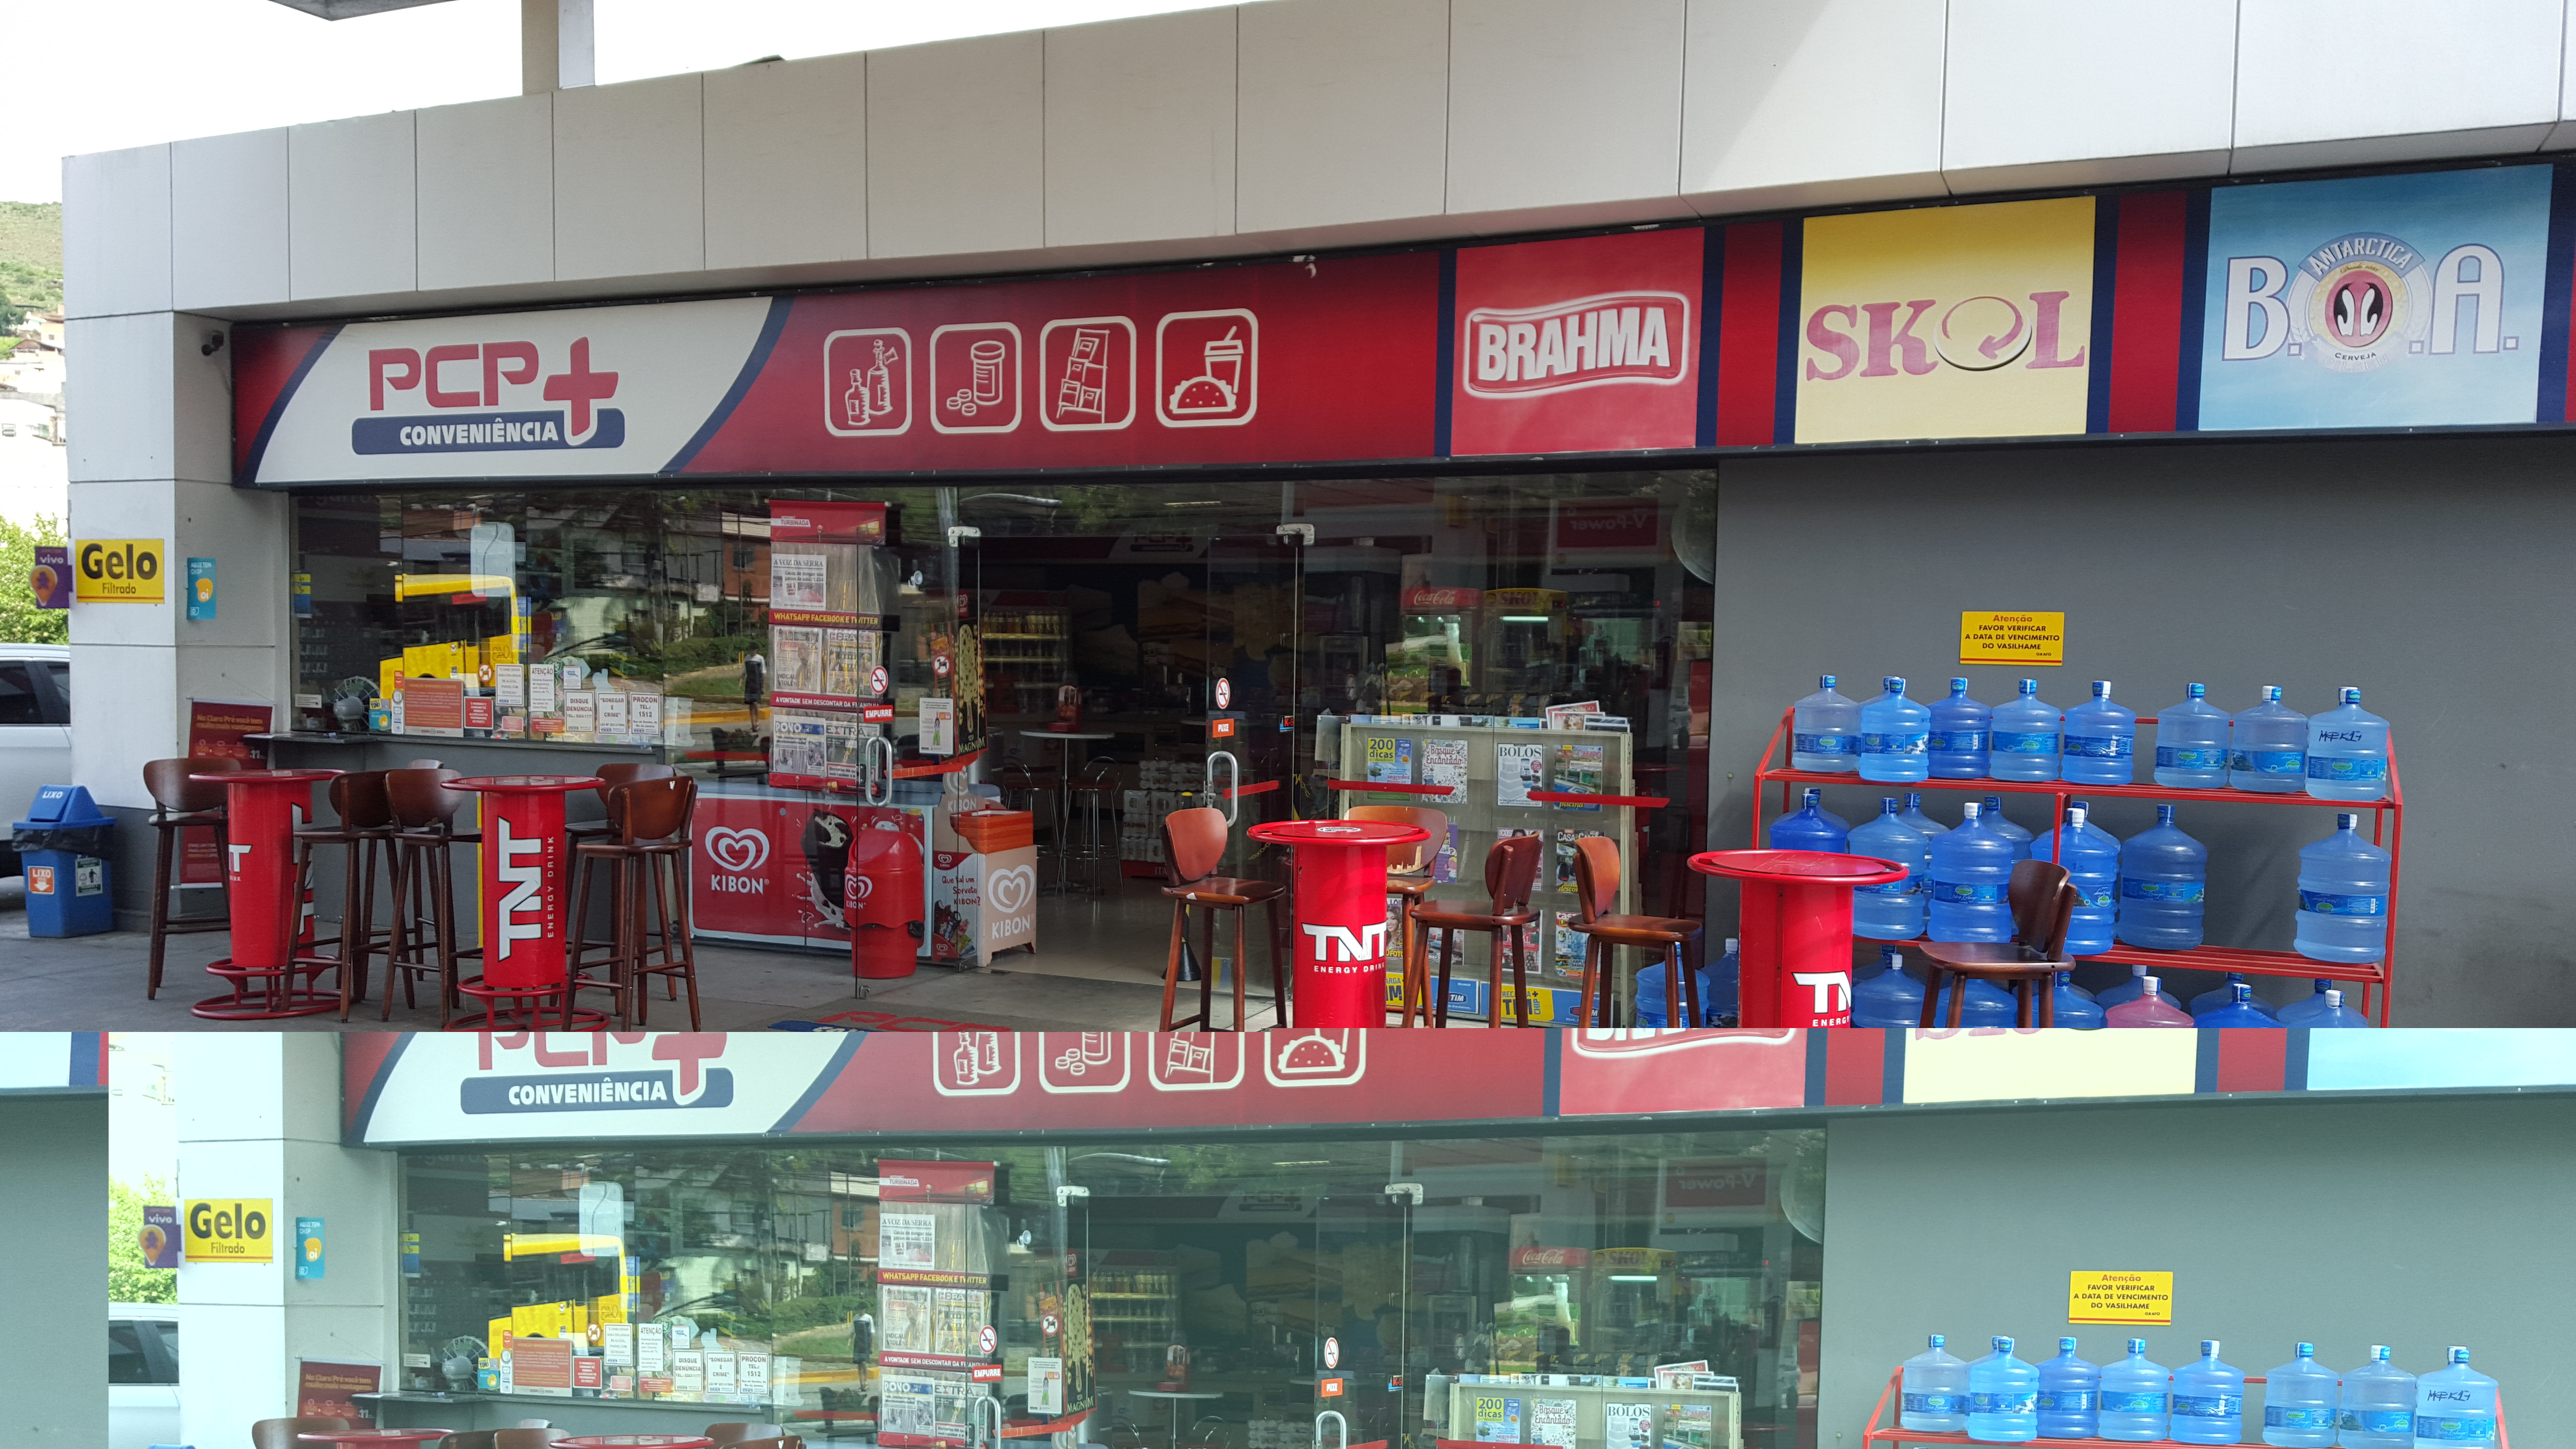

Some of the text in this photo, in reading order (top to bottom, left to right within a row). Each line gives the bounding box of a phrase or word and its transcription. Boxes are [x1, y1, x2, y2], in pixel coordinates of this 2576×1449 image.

[2307, 237, 2413, 275] ANTARCTICA
[1805, 290, 2085, 381] SKOL
[1478, 306, 1670, 382] BRAHMA
[2334, 352, 2377, 361] CERVEJA
[400, 418, 559, 446] CONVENIÊNCIA
[40, 554, 64, 564] vivo
[81, 543, 157, 580] Gelo
[102, 582, 136, 594] Filtrado
[200, 588, 209, 599] oi
[773, 612, 810, 621] WHATSAPP
[811, 614, 845, 623] FACEBOOK
[851, 616, 878, 625] TWITTER
[1993, 614, 2033, 624] Atenção
[532, 667, 553, 676] ATENÇÃO
[865, 708, 892, 718] EMPURRE
[776, 723, 801, 733] POVO
[826, 725, 866, 737] EXTRA
[1217, 724, 1229, 732] PUXE
[959, 737, 985, 754] MAGNUM
[1369, 739, 1393, 750] 200
[1369, 750, 1393, 759] dicas
[1430, 745, 1456, 756] Bosque
[1499, 747, 1542, 757] BOLOS
[1426, 755, 1464, 766] Encantado
[42, 791, 64, 799] LIXO
[948, 798, 977, 813] KIBON
[1558, 832, 1575, 841] CASA
[32, 869, 51, 878] LIXO
[711, 874, 764, 894] KIBON
[942, 876, 954, 884] Que
[498, 816, 543, 962] TNT
[846, 900, 864, 909] KIBON
[954, 896, 981, 906] KIBON?
[992, 915, 1030, 939] KIBON
[1301, 922, 1387, 962] TNT
[1314, 964, 1385, 974] ENERGY DRINK
[509, 1077, 667, 1106] CONVENIÊNCIA
[148, 1214, 173, 1224] vivo
[190, 1202, 266, 1240] Gelo
[211, 1242, 245, 1254] Filtrado
[882, 1272, 919, 1281] WHATSAPP
[919, 1273, 953, 1282] FACEBOOK
[2102, 1274, 2141, 1283] Atenção
[641, 1326, 662, 1336] ATENÇÃO
[974, 1368, 1001, 1378] EMPURRE
[935, 1385, 974, 1397] EXTRA
[1326, 1383, 1338, 1392] PUXE
[1067, 1397, 1094, 1413] MAGNUM
[1478, 1398, 1502, 1409] 200
[1478, 1410, 1502, 1418] dicas
[1539, 1404, 1564, 1415] Bosque
[1608, 1406, 1650, 1417] BOLOS
[1535, 1414, 1572, 1425] Encantado
